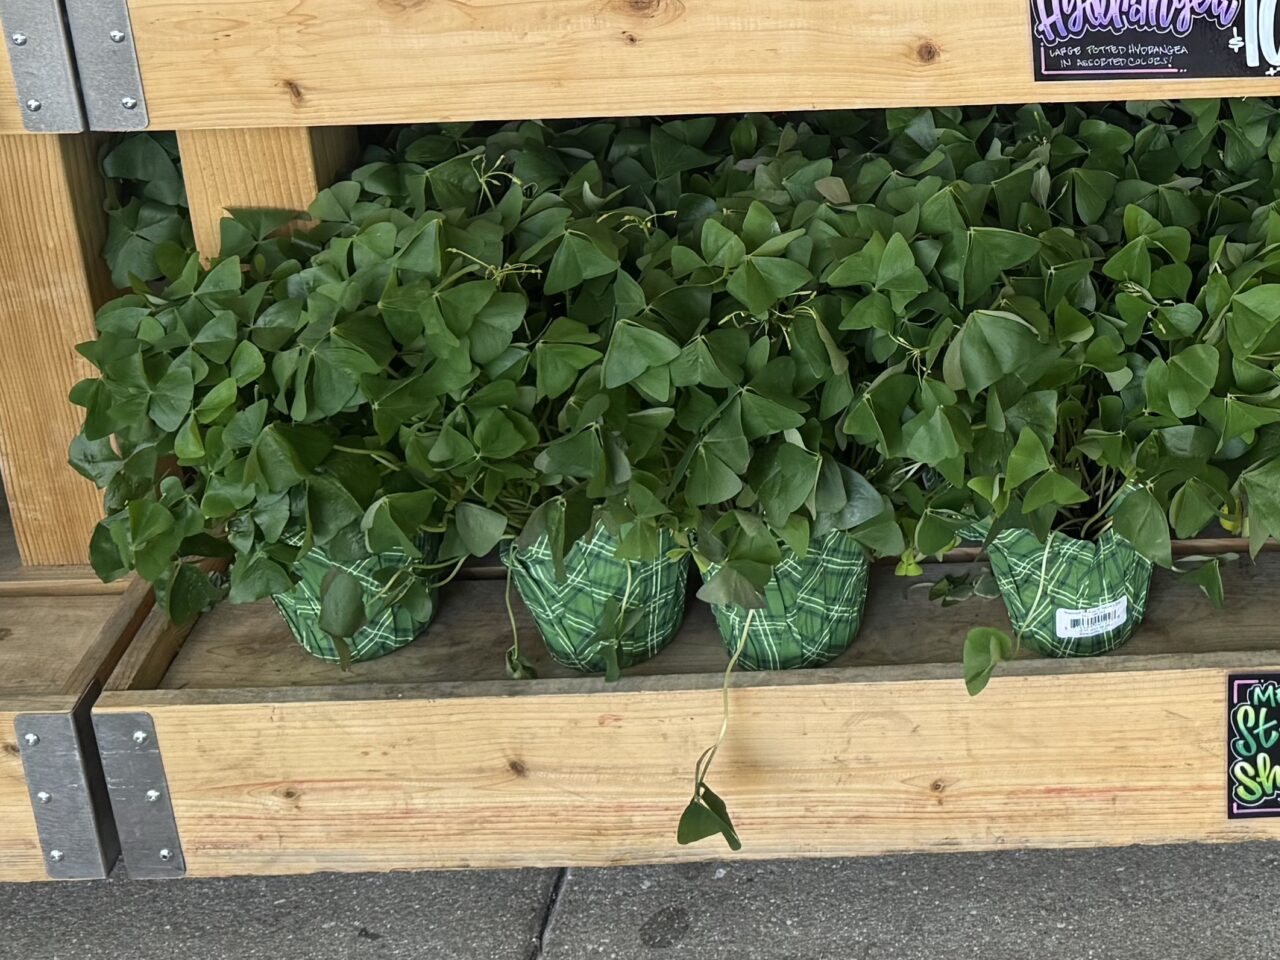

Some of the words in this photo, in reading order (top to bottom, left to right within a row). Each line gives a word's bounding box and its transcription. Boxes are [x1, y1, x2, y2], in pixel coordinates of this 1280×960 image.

[1049, 46, 1082, 57] LARGE
[1086, 44, 1127, 55] POTTED
[1128, 43, 1189, 55] HYDRANGEA
[1060, 58, 1071, 68] IN
[1077, 58, 1127, 68] ASSORTED
[1127, 55, 1173, 68] COLORS!
